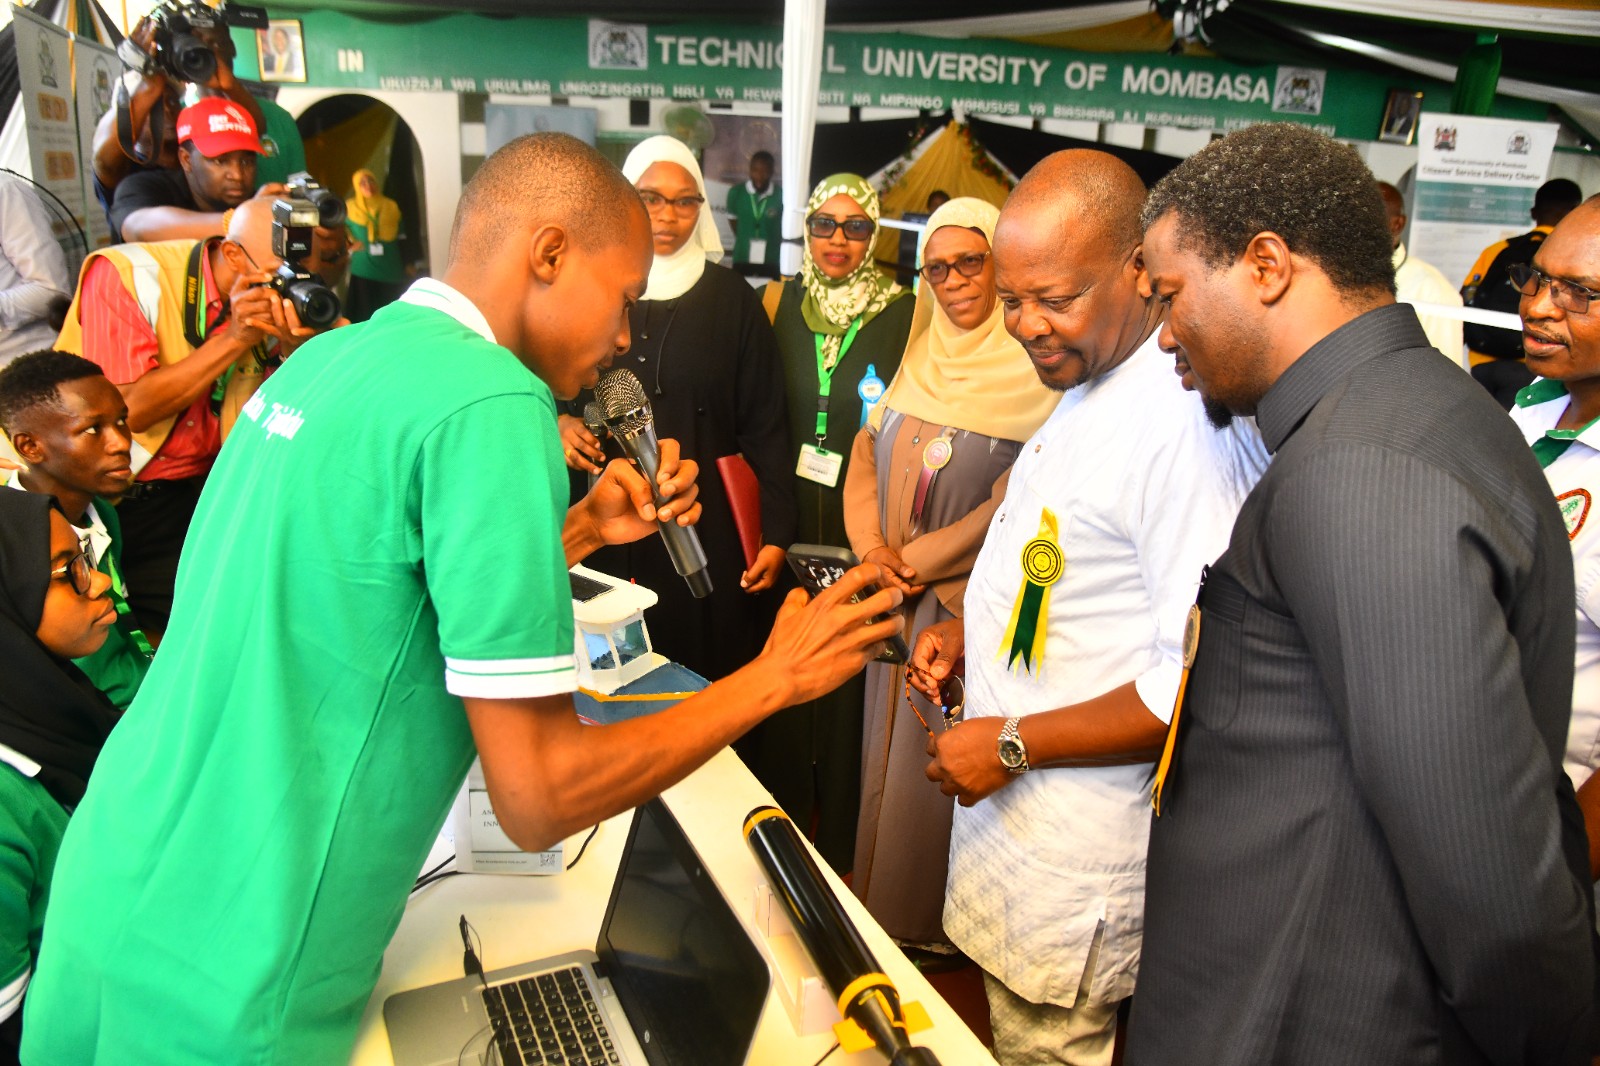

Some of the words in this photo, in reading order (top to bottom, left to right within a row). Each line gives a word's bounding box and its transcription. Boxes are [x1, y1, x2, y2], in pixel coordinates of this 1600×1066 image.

[655, 35, 846, 74] TECHNIL
[863, 47, 1050, 87] UNIVERSITY
[1064, 62, 1107, 91] OF
[1122, 65, 1270, 104] MOMBASA
[380, 76, 443, 92] UKUZAJI
[450, 78, 477, 93] WA
[673, 84, 705, 99] HALI
[715, 86, 734, 99] YA
[853, 92, 871, 106] NA
[880, 93, 943, 110] MIPANGO
[1029, 102, 1046, 116] YA
[187, 275, 199, 305] Nikon
